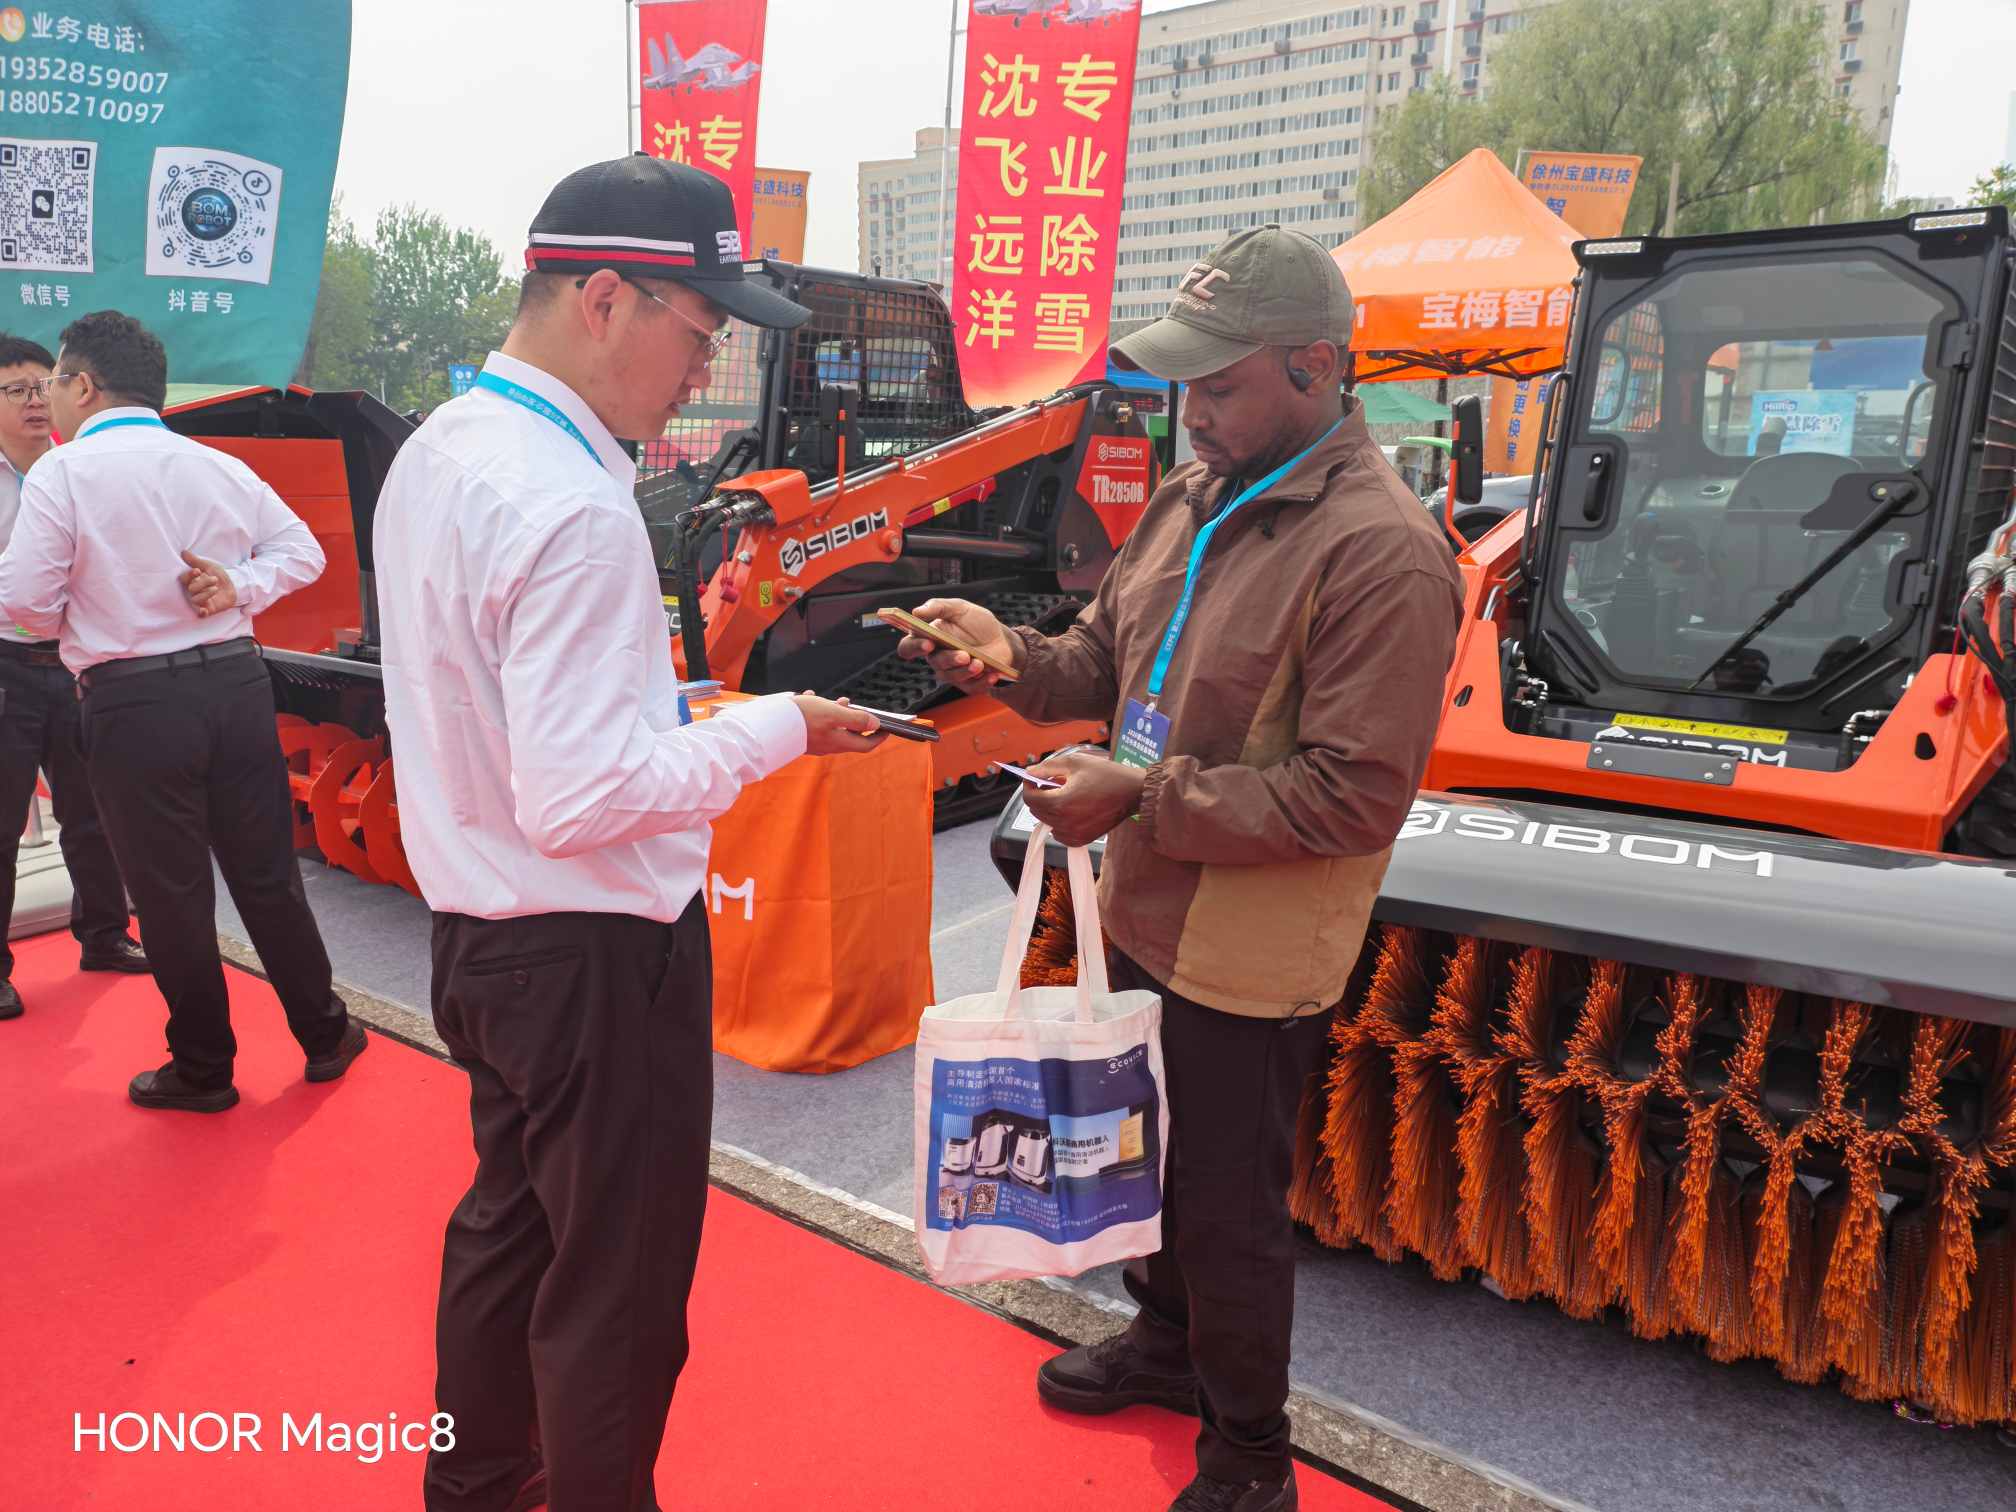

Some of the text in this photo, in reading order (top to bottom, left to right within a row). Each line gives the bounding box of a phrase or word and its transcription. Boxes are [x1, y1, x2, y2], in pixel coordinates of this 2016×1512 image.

[0, 56, 169, 94] 19352859007
[0, 89, 165, 124] 18805210097
[964, 52, 1040, 352] 沈飞远洋
[1033, 52, 1119, 355] 专业除雪
[20, 282, 72, 308] 微信号
[167, 288, 236, 314] 抖音号
[1108, 446, 1143, 459] SIBOM
[1092, 474, 1145, 503] TR2850B
[805, 506, 889, 560] SIBOM
[1453, 810, 1774, 879] SIBOM
